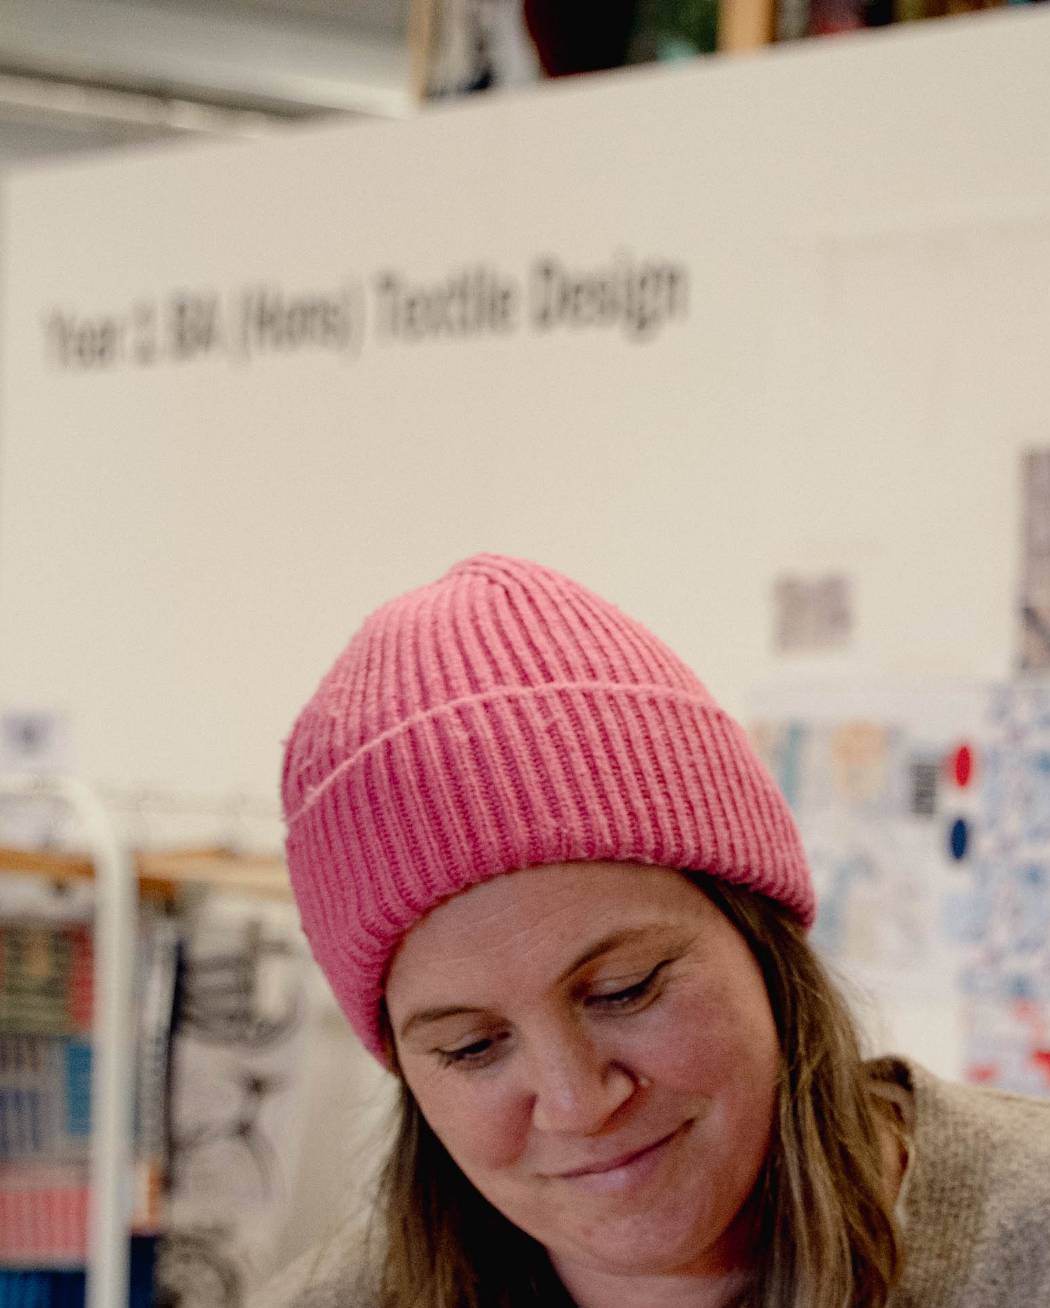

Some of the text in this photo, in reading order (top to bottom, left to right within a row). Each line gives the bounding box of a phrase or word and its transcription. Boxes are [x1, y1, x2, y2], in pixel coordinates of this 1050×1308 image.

[44, 301, 122, 370] Year
[167, 288, 220, 362] BA
[376, 264, 518, 340] Textile
[534, 252, 688, 341] Design
